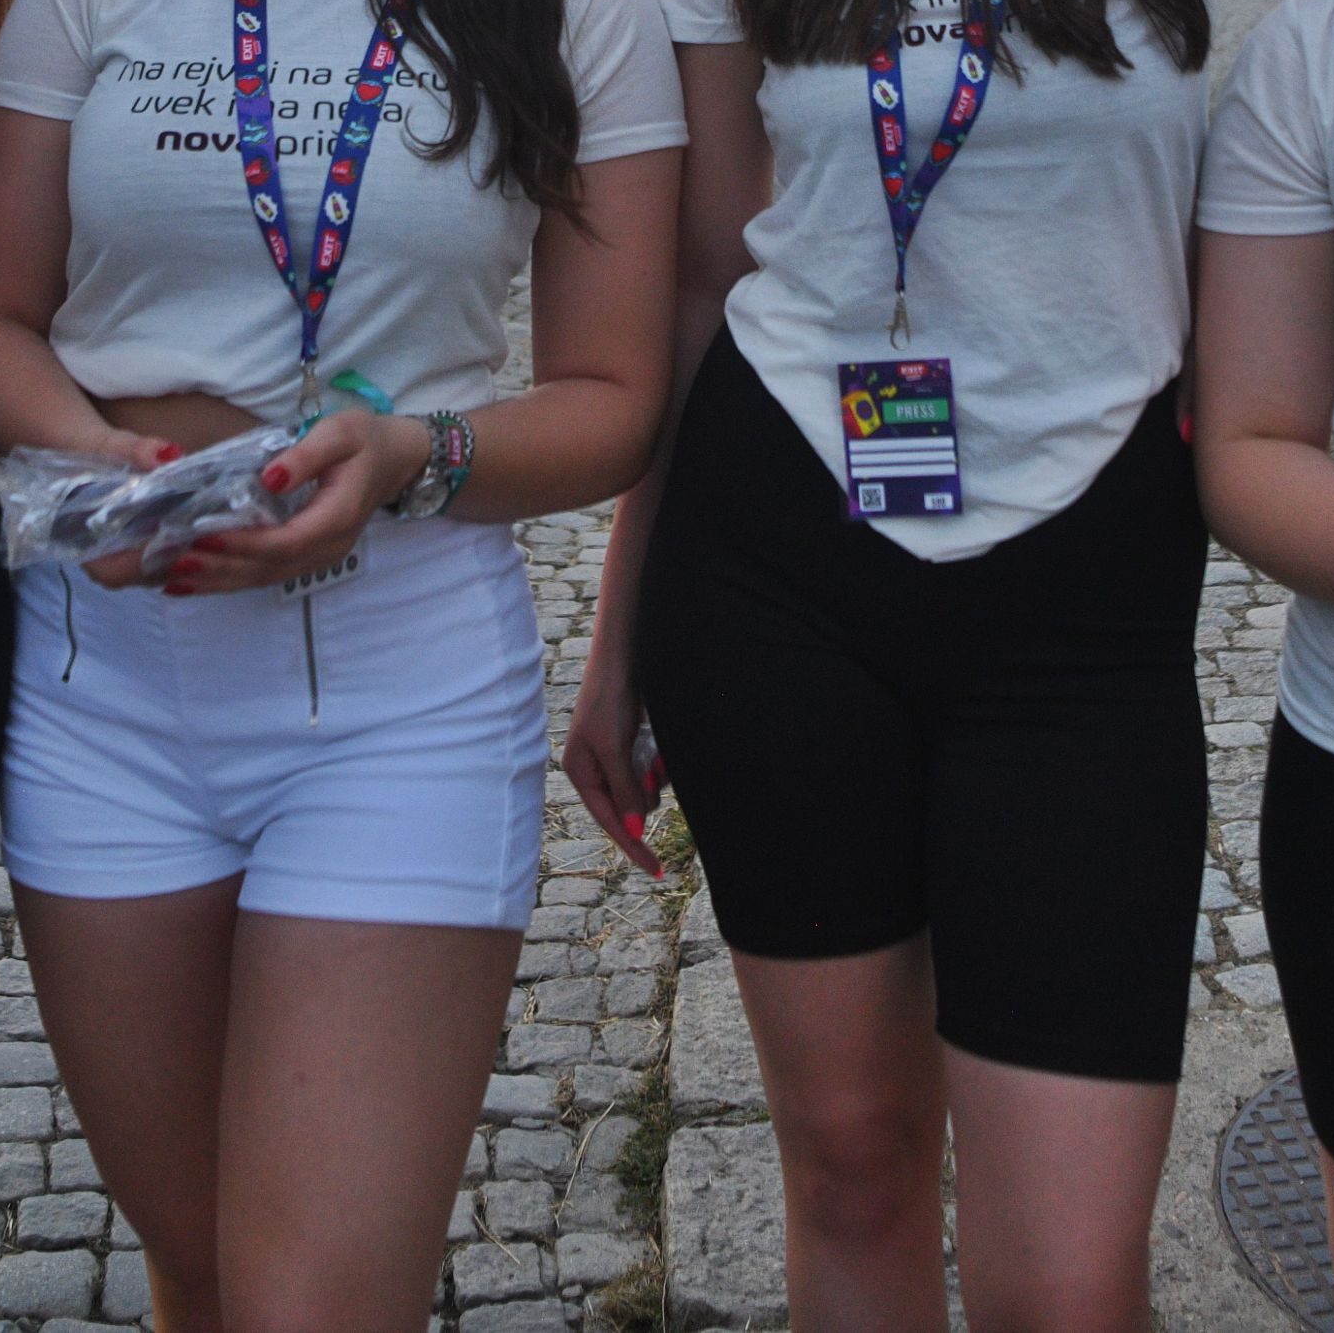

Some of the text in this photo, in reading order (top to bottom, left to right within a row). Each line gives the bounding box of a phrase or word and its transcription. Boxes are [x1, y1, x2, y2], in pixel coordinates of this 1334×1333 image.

[242, 38, 254, 61] EXIT
[372, 44, 388, 67] EXIT
[172, 57, 236, 87] rejv
[269, 60, 279, 83] i
[288, 67, 331, 86] na
[131, 89, 216, 115] uvek
[953, 89, 970, 121] EXIT
[156, 130, 244, 152] nov
[882, 121, 896, 151] EXIT
[320, 235, 335, 267] EXIT
[895, 404, 936, 419] PRESS
